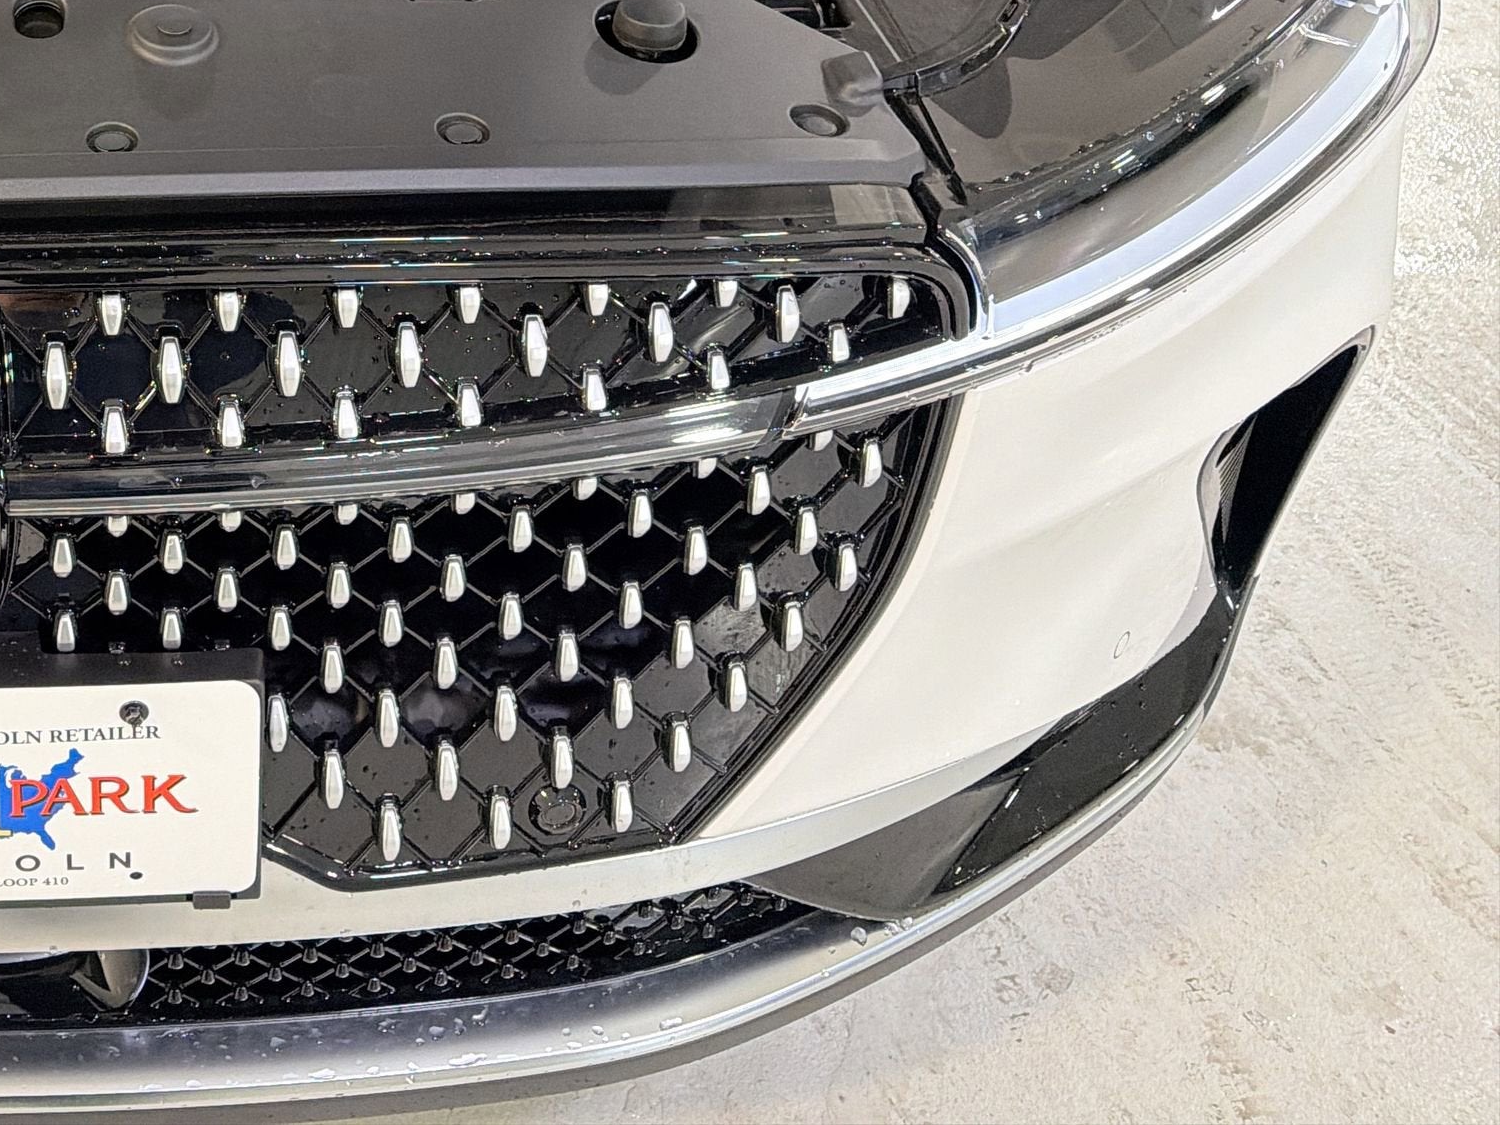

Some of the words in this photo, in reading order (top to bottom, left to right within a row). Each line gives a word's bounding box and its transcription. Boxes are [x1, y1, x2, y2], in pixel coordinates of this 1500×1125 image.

[50, 725, 161, 744] RETAILER
[9, 774, 199, 818] PARK
[42, 876, 70, 886] 410
